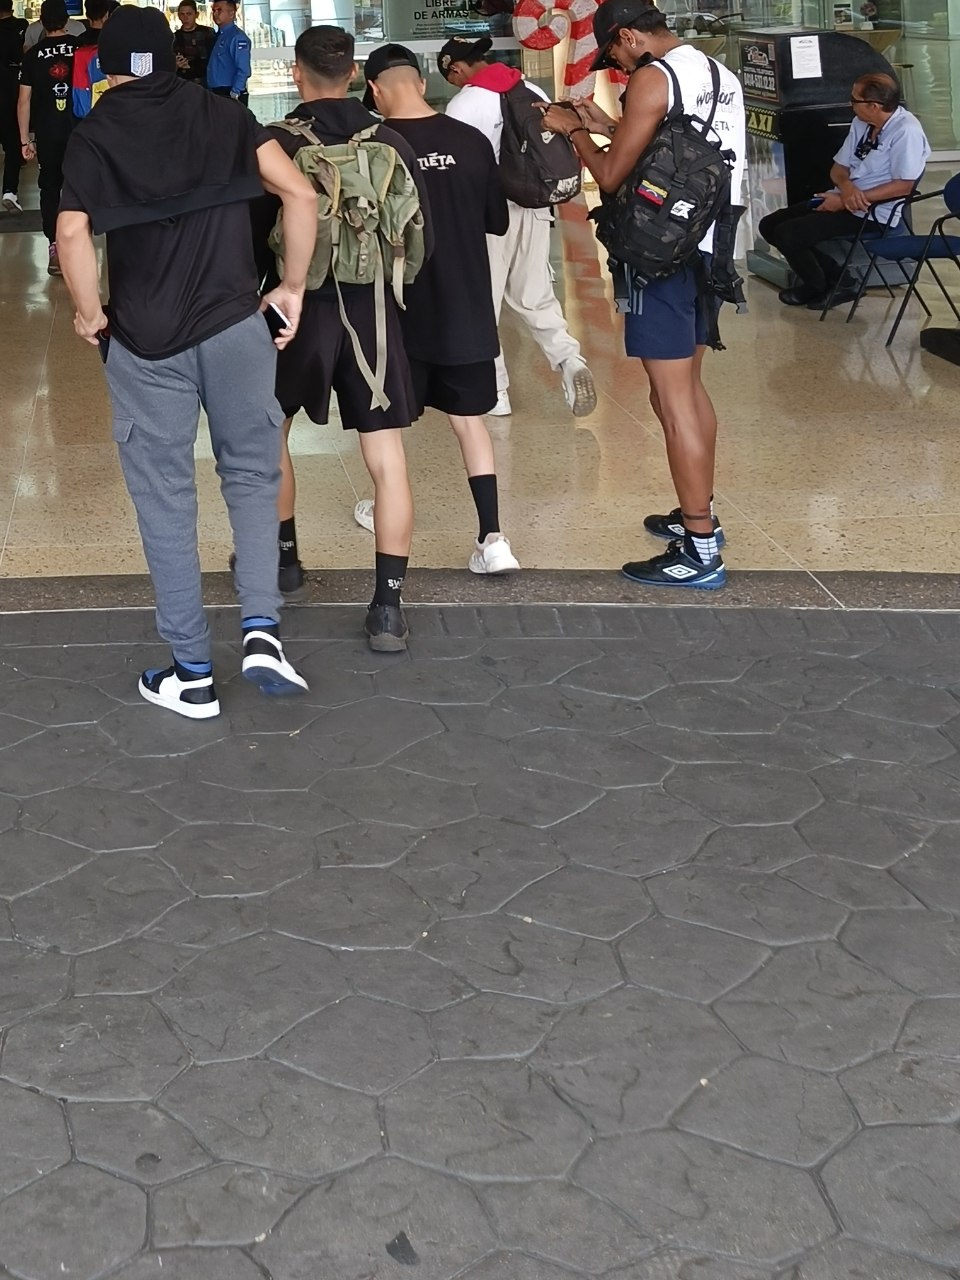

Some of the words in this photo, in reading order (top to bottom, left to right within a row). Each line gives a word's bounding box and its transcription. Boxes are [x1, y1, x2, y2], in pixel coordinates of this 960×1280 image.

[414, 10, 428, 21] DE
[431, 9, 470, 20] ARMAS
[696, 91, 736, 107] WOROUT
[746, 110, 773, 132] AXI
